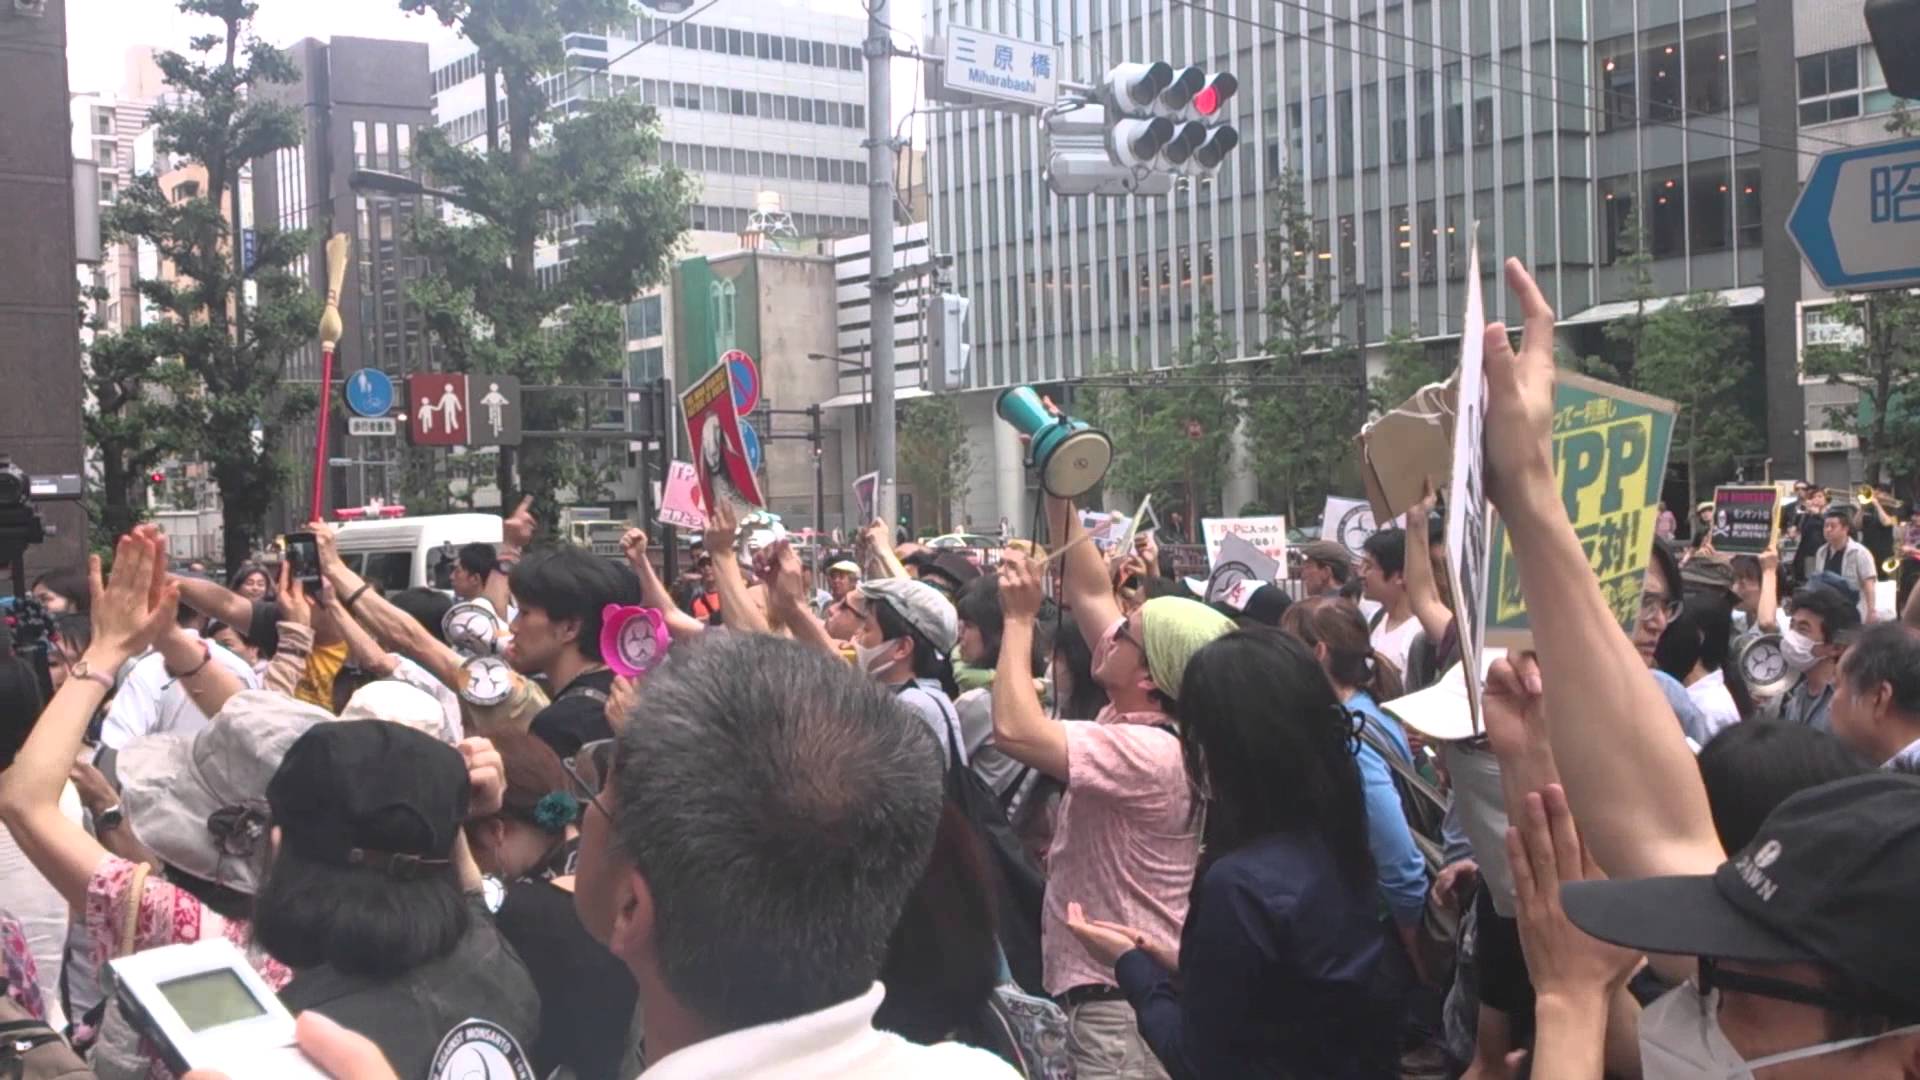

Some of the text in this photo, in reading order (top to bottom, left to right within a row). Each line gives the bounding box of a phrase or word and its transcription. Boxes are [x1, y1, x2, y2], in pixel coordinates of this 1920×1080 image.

[956, 36, 1050, 80] 三原橋
[968, 68, 1036, 93] Miharabashi
[1553, 420, 1648, 523] PP
[437, 1030, 465, 1072] AGAINST
[465, 1026, 513, 1055] MONSANTO
